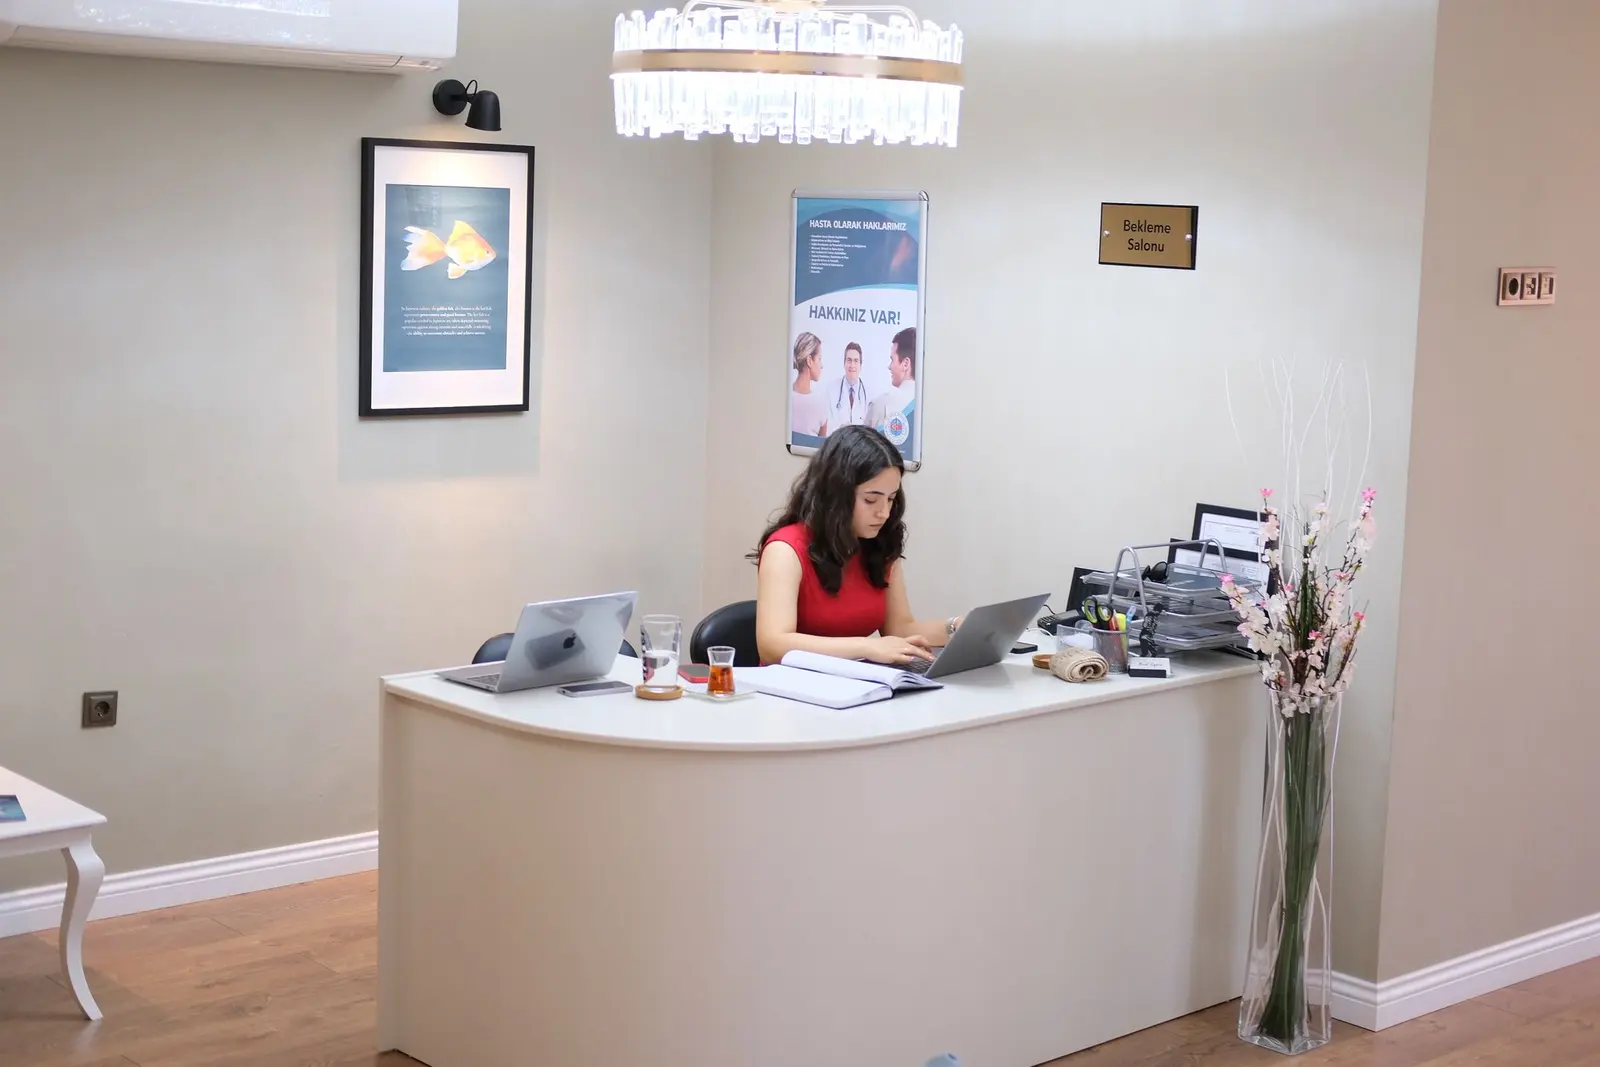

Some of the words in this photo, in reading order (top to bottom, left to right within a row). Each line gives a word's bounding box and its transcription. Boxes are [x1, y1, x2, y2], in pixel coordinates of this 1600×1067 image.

[809, 219, 833, 229] HASTA
[833, 220, 862, 230] OLARAK
[862, 221, 907, 231] HAKLARIMIZ
[1123, 219, 1171, 234] Bekleme
[1127, 238, 1165, 252] Salonu
[809, 304, 866, 323] HAKKINIZ
[870, 309, 901, 326] VAR!
